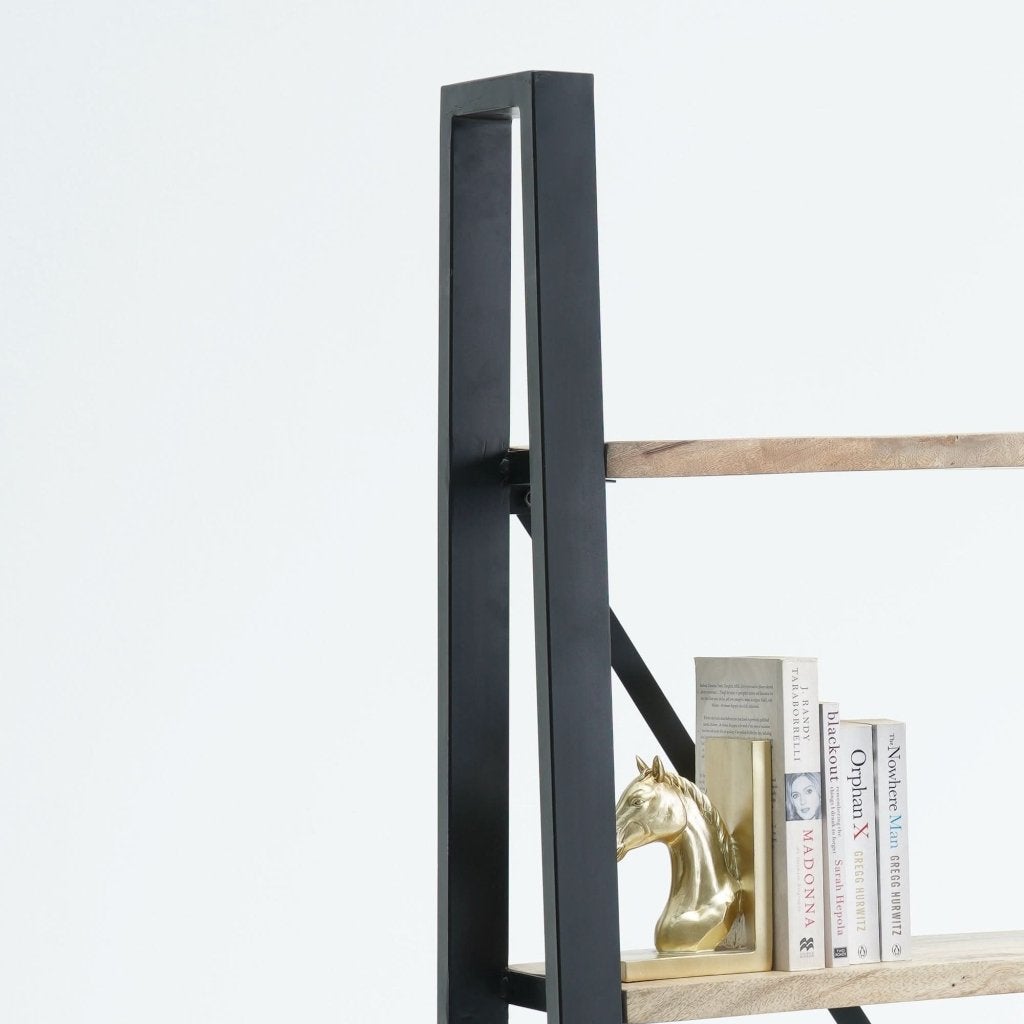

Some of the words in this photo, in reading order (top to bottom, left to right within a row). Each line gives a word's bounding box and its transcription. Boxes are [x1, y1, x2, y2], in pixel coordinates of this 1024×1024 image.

[792, 667, 801, 761] TARABORRELLI
[802, 700, 810, 741] RANDY
[827, 711, 840, 783] blackout
[847, 749, 867, 820] Orphan
[887, 745, 901, 812] Nowhere
[853, 822, 869, 841] X
[889, 815, 902, 849] Man
[803, 828, 815, 928] MADONNA
[834, 859, 844, 891] Sarah
[853, 850, 864, 883] GREGG
[890, 855, 900, 888] GREGG
[834, 895, 845, 936] Hepola
[855, 887, 866, 932] HURWITZ
[891, 892, 902, 936] HURWITZ
